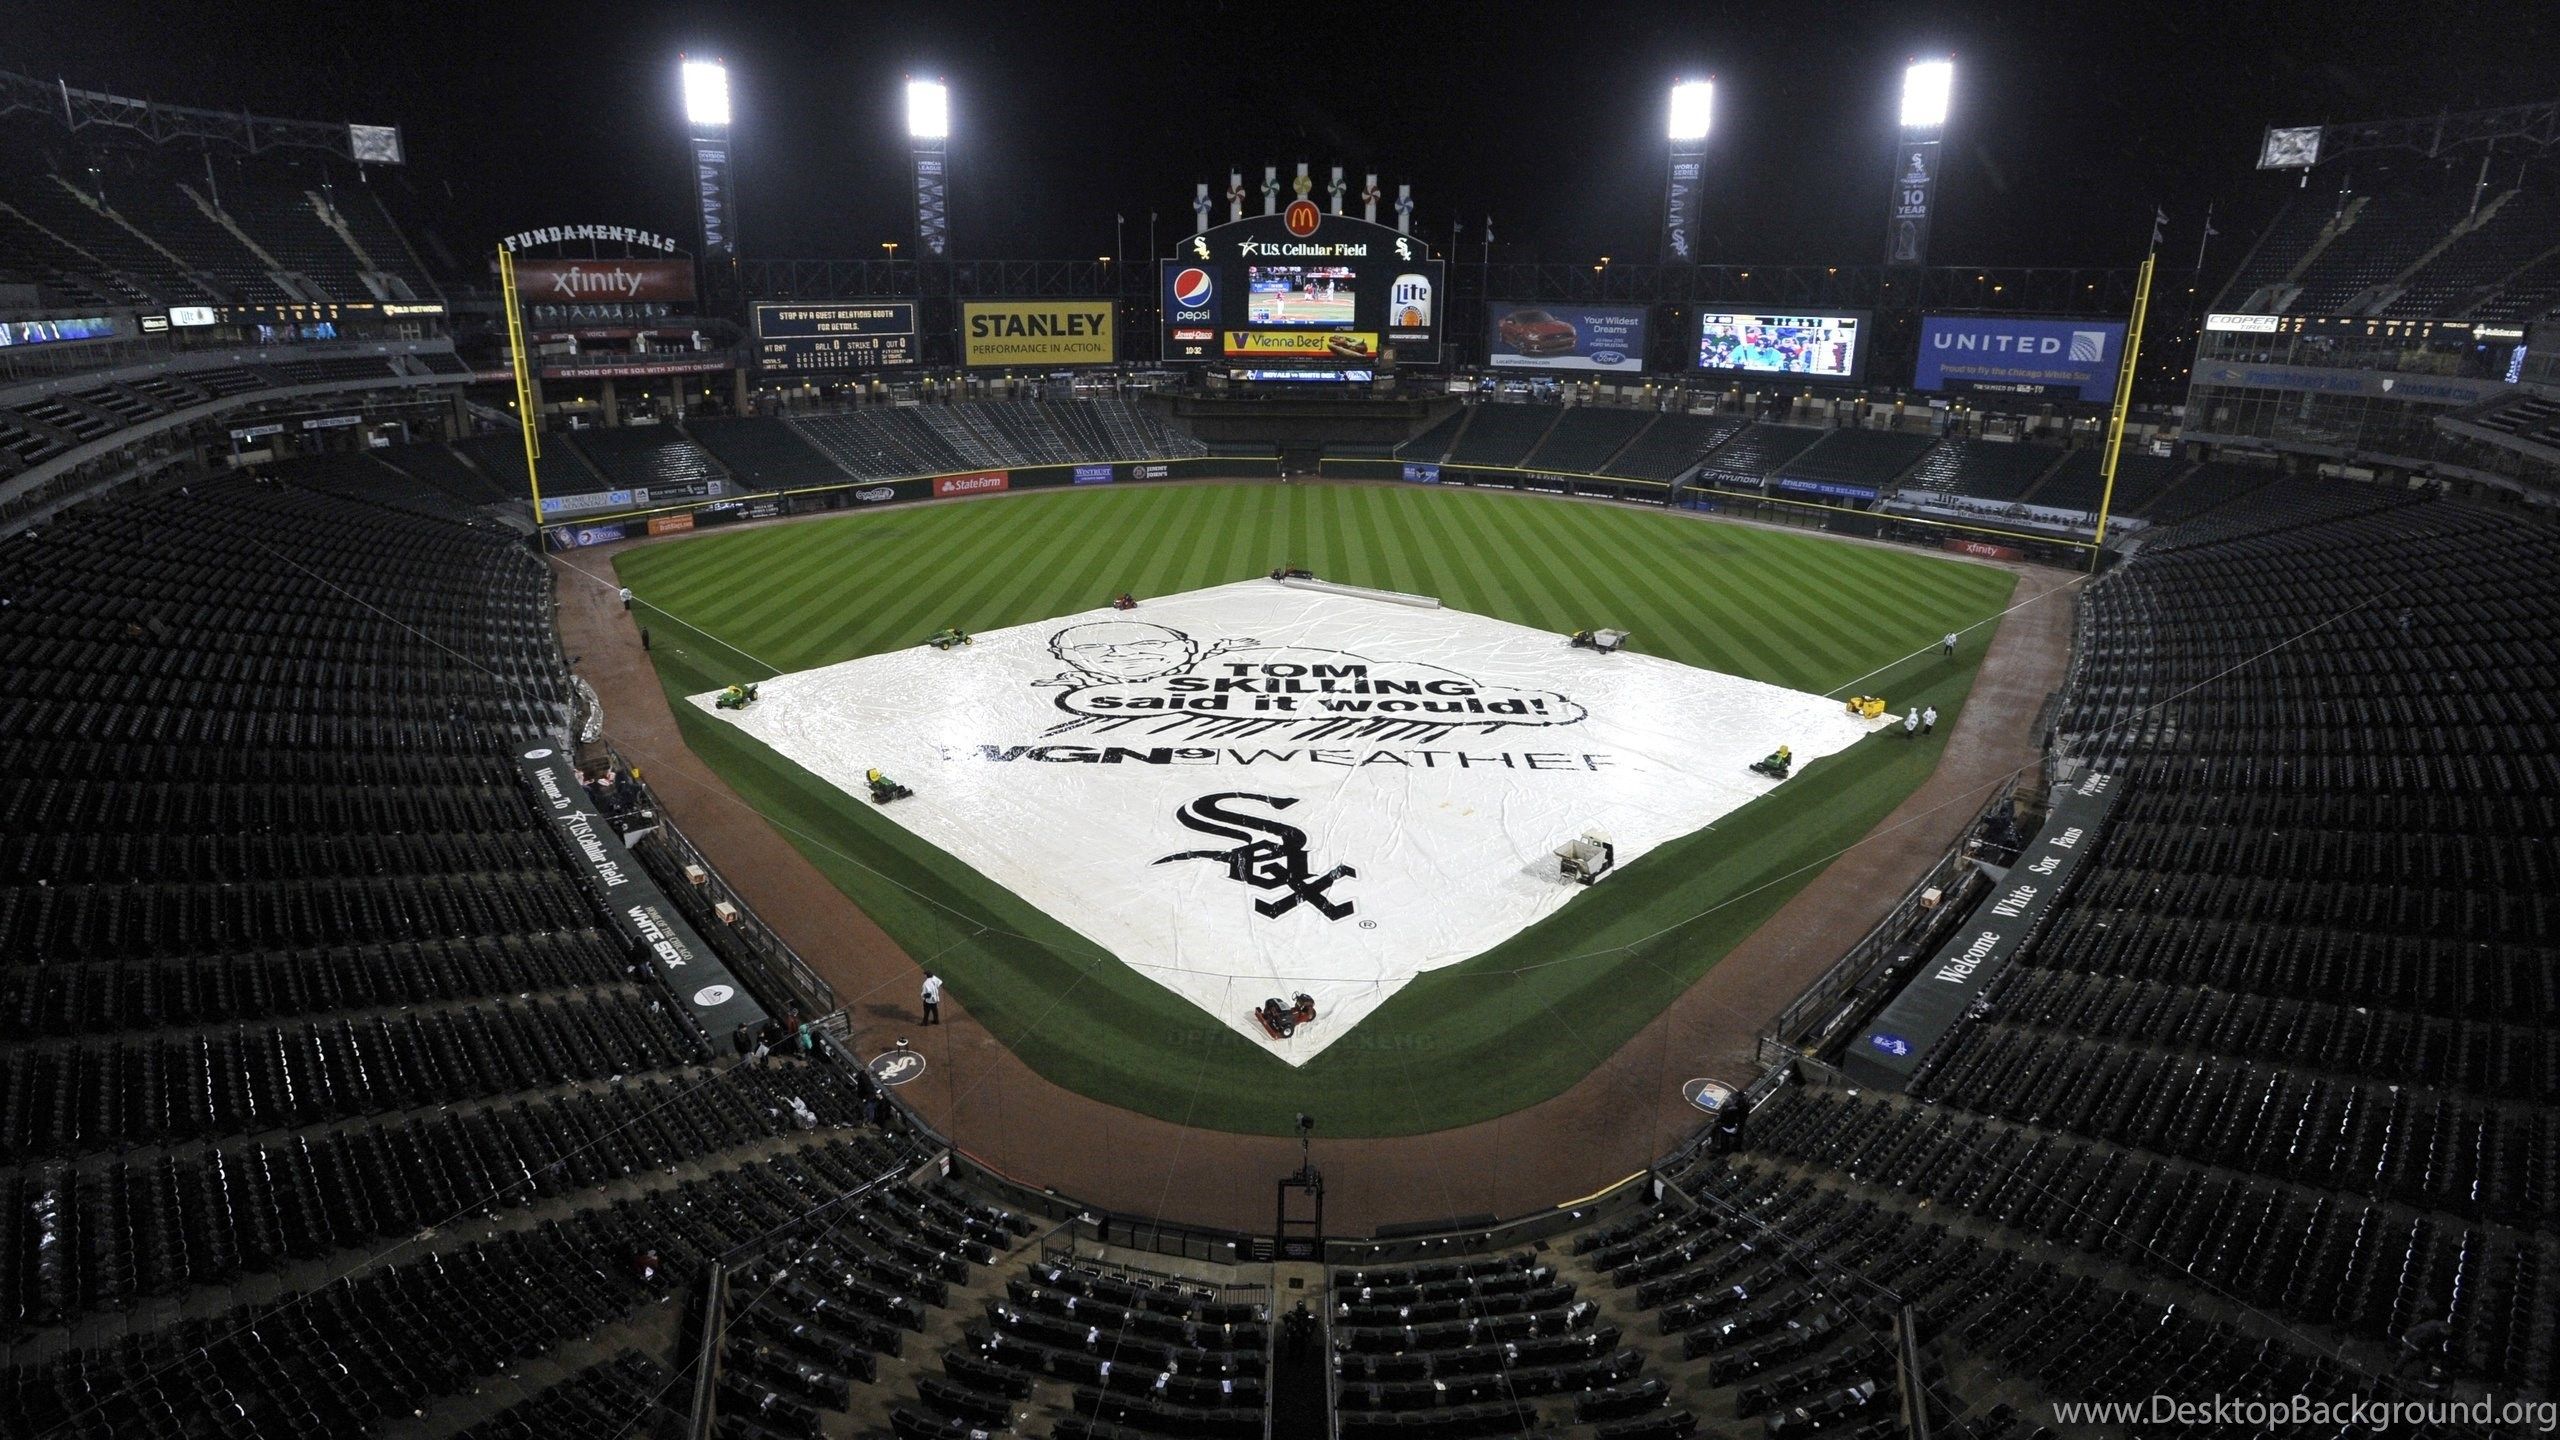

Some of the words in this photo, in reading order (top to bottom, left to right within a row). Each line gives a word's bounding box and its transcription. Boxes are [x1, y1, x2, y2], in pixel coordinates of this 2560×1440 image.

[1903, 190, 1924, 205] 10
[1898, 206, 1926, 214] YEAR
[504, 225, 675, 252] FUNDAMENTALS
[1282, 244, 1332, 256] Cellular
[1334, 244, 1367, 256] Field
[552, 267, 643, 298] xfinity
[1396, 284, 1427, 304] Lite
[779, 311, 798, 320] STOP
[799, 311, 808, 320] BY
[809, 310, 814, 319] A
[816, 310, 836, 319] GUEST
[838, 310, 872, 319] RELATIONS
[873, 310, 893, 318] BOOTH
[1176, 310, 1210, 322] pepsi
[1584, 316, 1603, 325] Your
[1605, 316, 1638, 326] Wildest
[2210, 316, 2276, 324] COOPER
[817, 323, 830, 331] FOR
[971, 314, 1105, 337] STANLEY
[1594, 326, 1627, 334] Dreams
[2280, 323, 2287, 332] 2
[2294, 324, 2301, 332] 2
[1174, 330, 1212, 338] Jewel-Osco
[834, 340, 840, 350] 0
[847, 342, 871, 350] STRIKE
[873, 339, 878, 348] 0
[886, 340, 898, 348] OUT
[900, 338, 906, 348] 0
[973, 344, 1048, 354] PERFORMANCE
[1050, 344, 1060, 352] IN
[1063, 343, 1102, 352] ACTION
[1252, 335, 1294, 347] Vienna
[1297, 335, 1325, 350] Beef
[1934, 332, 2061, 354] UNITED
[1596, 353, 1620, 363] Ford
[702, 362, 724, 370] DEMAND
[1940, 364, 1966, 373] Proud
[1967, 365, 1976, 373] to
[1978, 364, 1988, 375] fly
[1992, 366, 2005, 375] the
[2008, 368, 2042, 378] Chicago
[2044, 370, 2072, 379] White
[2072, 372, 2090, 380] Sox
[955, 480, 978, 490] State
[978, 478, 1000, 487] Farm
[1718, 474, 1759, 485] HYUNDAI
[1781, 478, 1817, 490] ATHLETICO
[562, 500, 608, 510] ADVANTAGE
[1966, 543, 1998, 556] xfinity
[1223, 664, 1368, 678] TOM
[1164, 677, 1476, 696] SKILLING
[1087, 694, 1229, 710] said
[1255, 694, 1298, 710] it
[1318, 697, 1549, 715] would!
[535, 768, 562, 800] Welcome
[552, 797, 571, 809] To
[576, 834, 607, 863] Cellular
[595, 861, 628, 886] Field
[1935, 931, 2000, 984] Welcome
[1991, 885, 2038, 917] White
[2028, 856, 2061, 875] Sox
[2049, 827, 2083, 849] Fans
[645, 906, 662, 922] HOME
[656, 920, 668, 928] OF
[627, 905, 664, 943] WHITE
[653, 941, 686, 969] SOX
[661, 926, 676, 937] THE
[669, 936, 694, 960] CHICAGO
